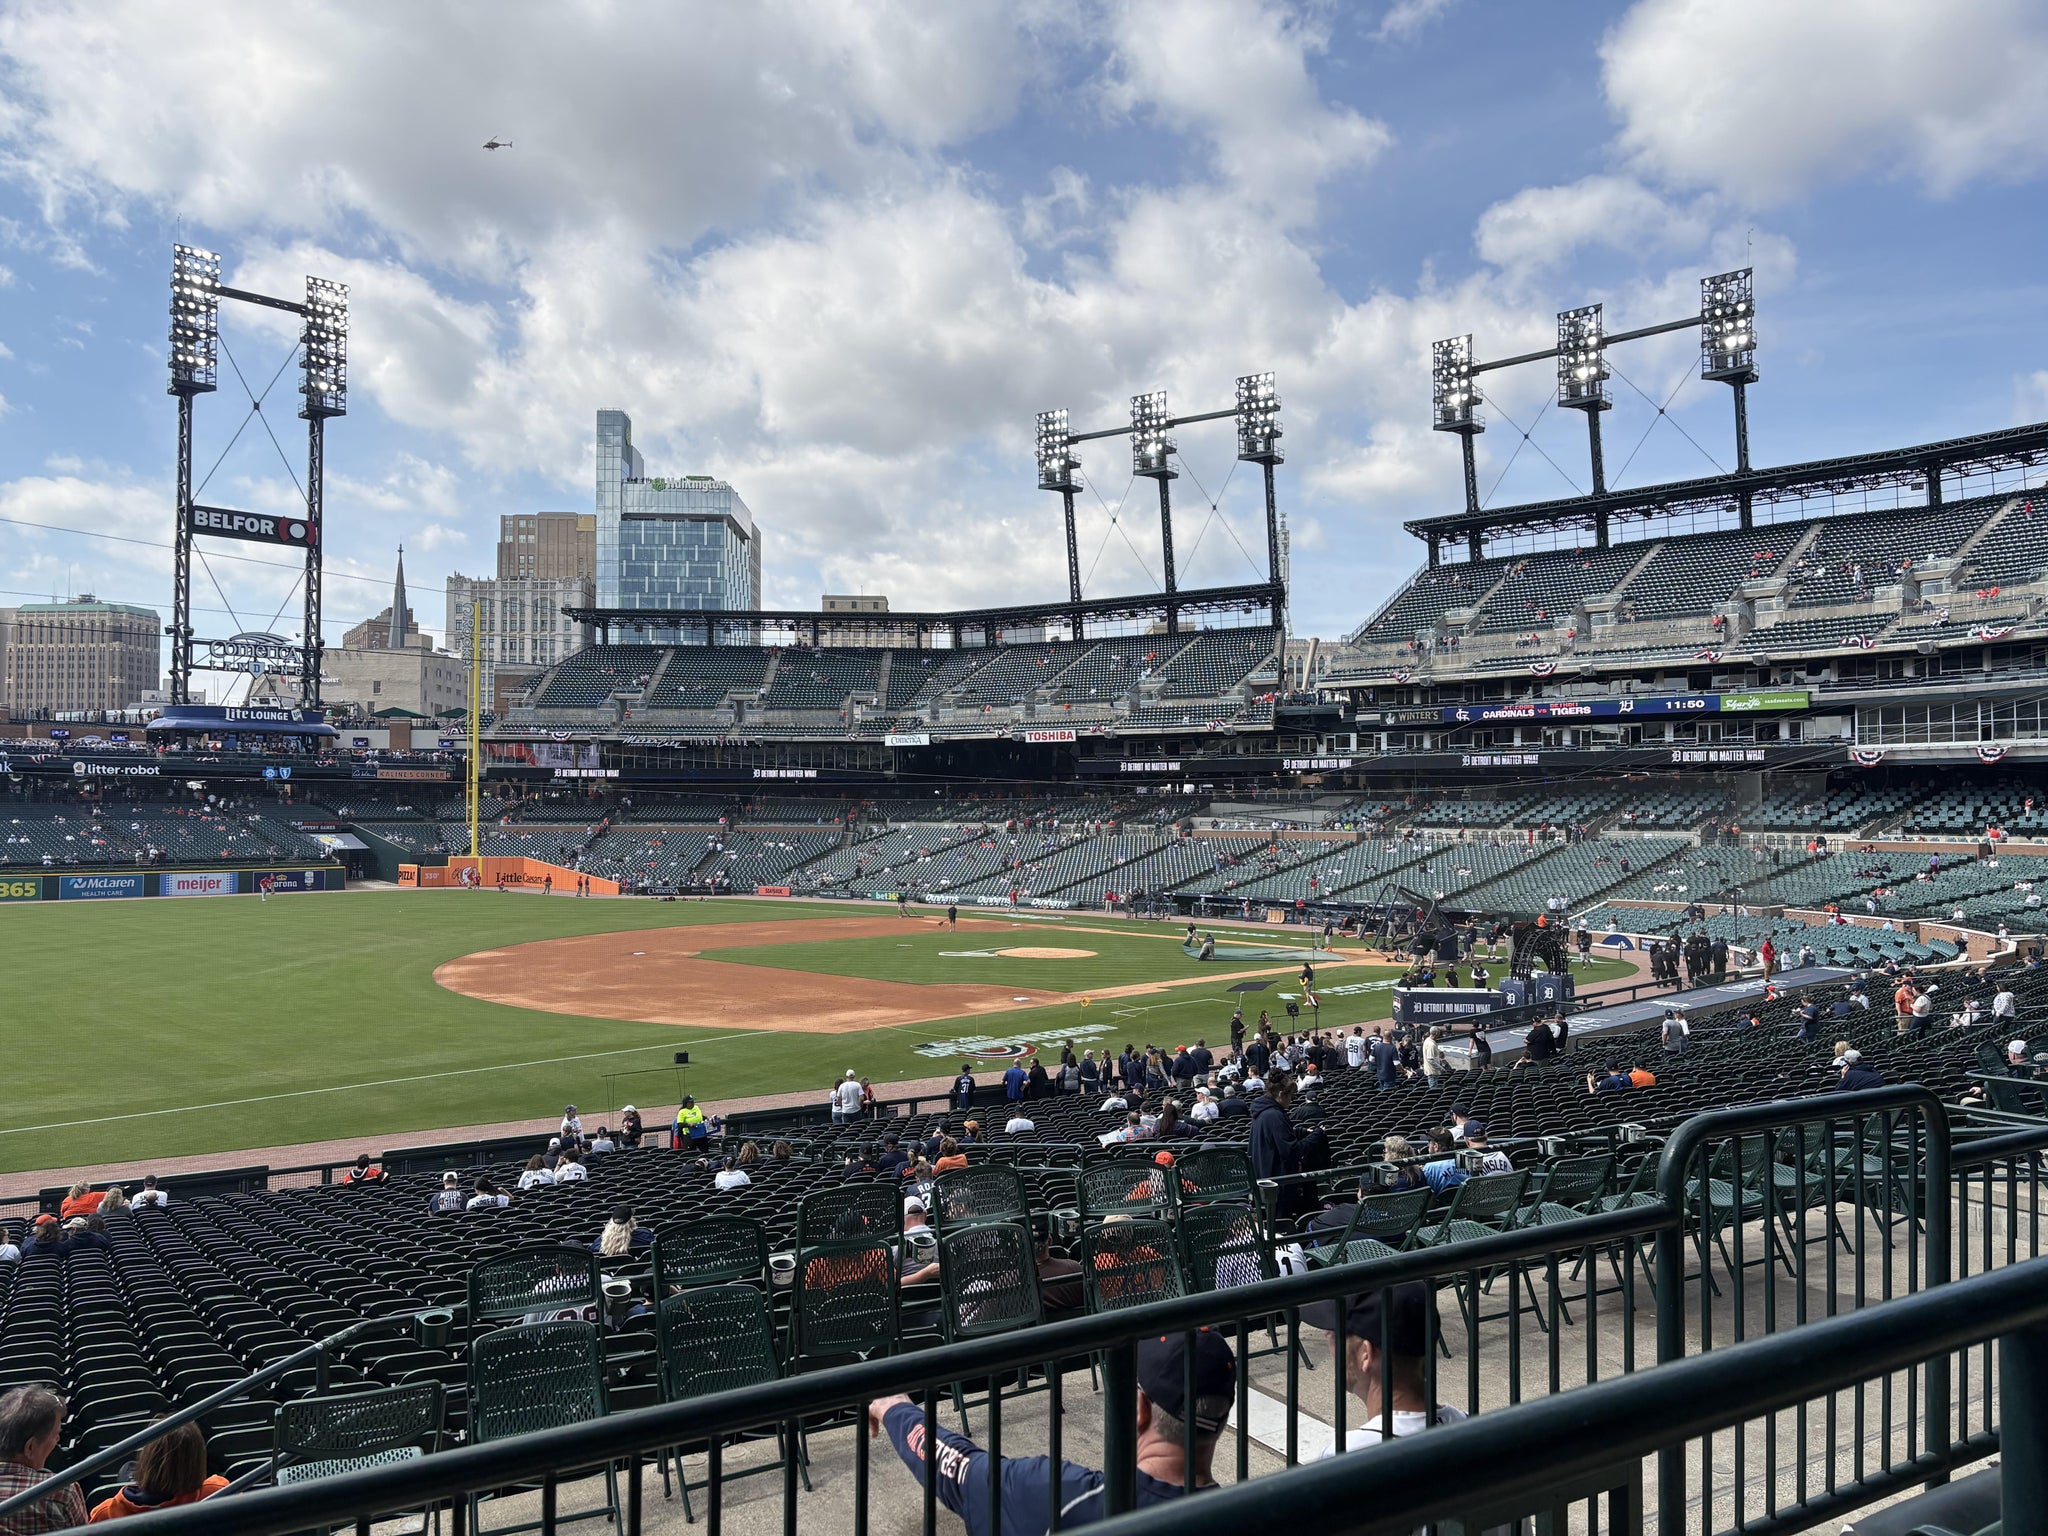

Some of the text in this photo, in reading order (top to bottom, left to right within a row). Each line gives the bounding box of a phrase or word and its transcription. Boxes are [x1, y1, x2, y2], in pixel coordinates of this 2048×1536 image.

[194, 510, 275, 535] BELFOR
[462, 618, 474, 671] Rocket
[1665, 700, 1706, 709] 11:50
[225, 708, 249, 720] Lite
[250, 711, 289, 720] LOUNGE
[1398, 711, 1439, 721] WINTER'S
[1482, 709, 1535, 719] CARDINALS
[1550, 706, 1592, 716] TIGERS
[1027, 731, 1074, 741] TOSHIBA
[1682, 751, 1707, 762] DETROIT
[1709, 750, 1718, 762] NO
[1720, 750, 1744, 761] MATTER
[1745, 750, 1765, 761] WHAT
[87, 878, 135, 889] McLaren
[177, 876, 222, 892] meijer
[1423, 1003, 1445, 1013] DETROIT
[1445, 1003, 1453, 1013] NO
[1454, 1003, 1475, 1013] MATTER
[1475, 1003, 1491, 1013] WHAT
[1348, 1044, 1359, 1053] 28
